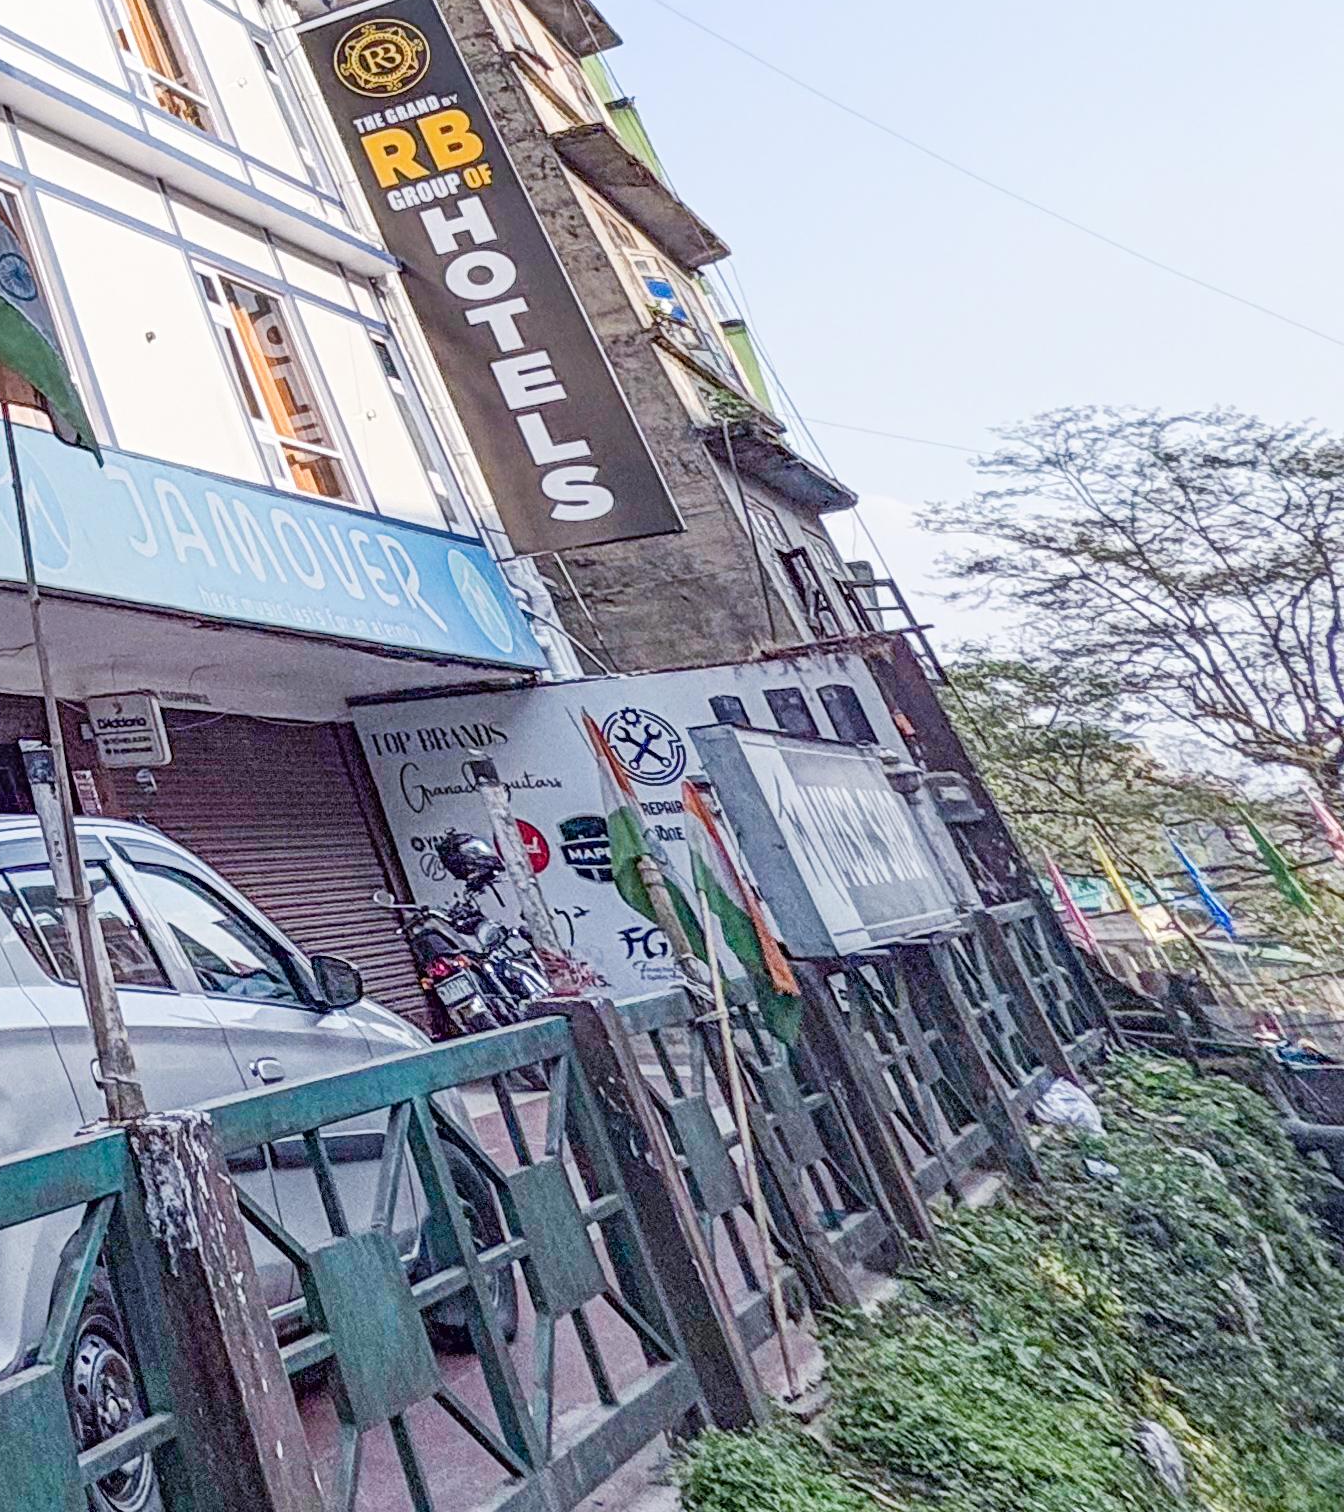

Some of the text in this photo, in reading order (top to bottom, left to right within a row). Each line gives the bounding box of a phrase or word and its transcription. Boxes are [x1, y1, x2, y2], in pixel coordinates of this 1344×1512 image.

[353, 93, 459, 134] THE GRAND BY
[361, 109, 484, 189] RB
[387, 163, 493, 212] GROUP OF
[419, 196, 614, 522] HOTELS
[104, 464, 448, 633] JAMOVER
[239, 596, 285, 620] music
[287, 601, 328, 628] lasts
[370, 721, 508, 756] TOP BRANDS
[400, 758, 482, 814] Granad
[640, 800, 685, 816] REPAIR
